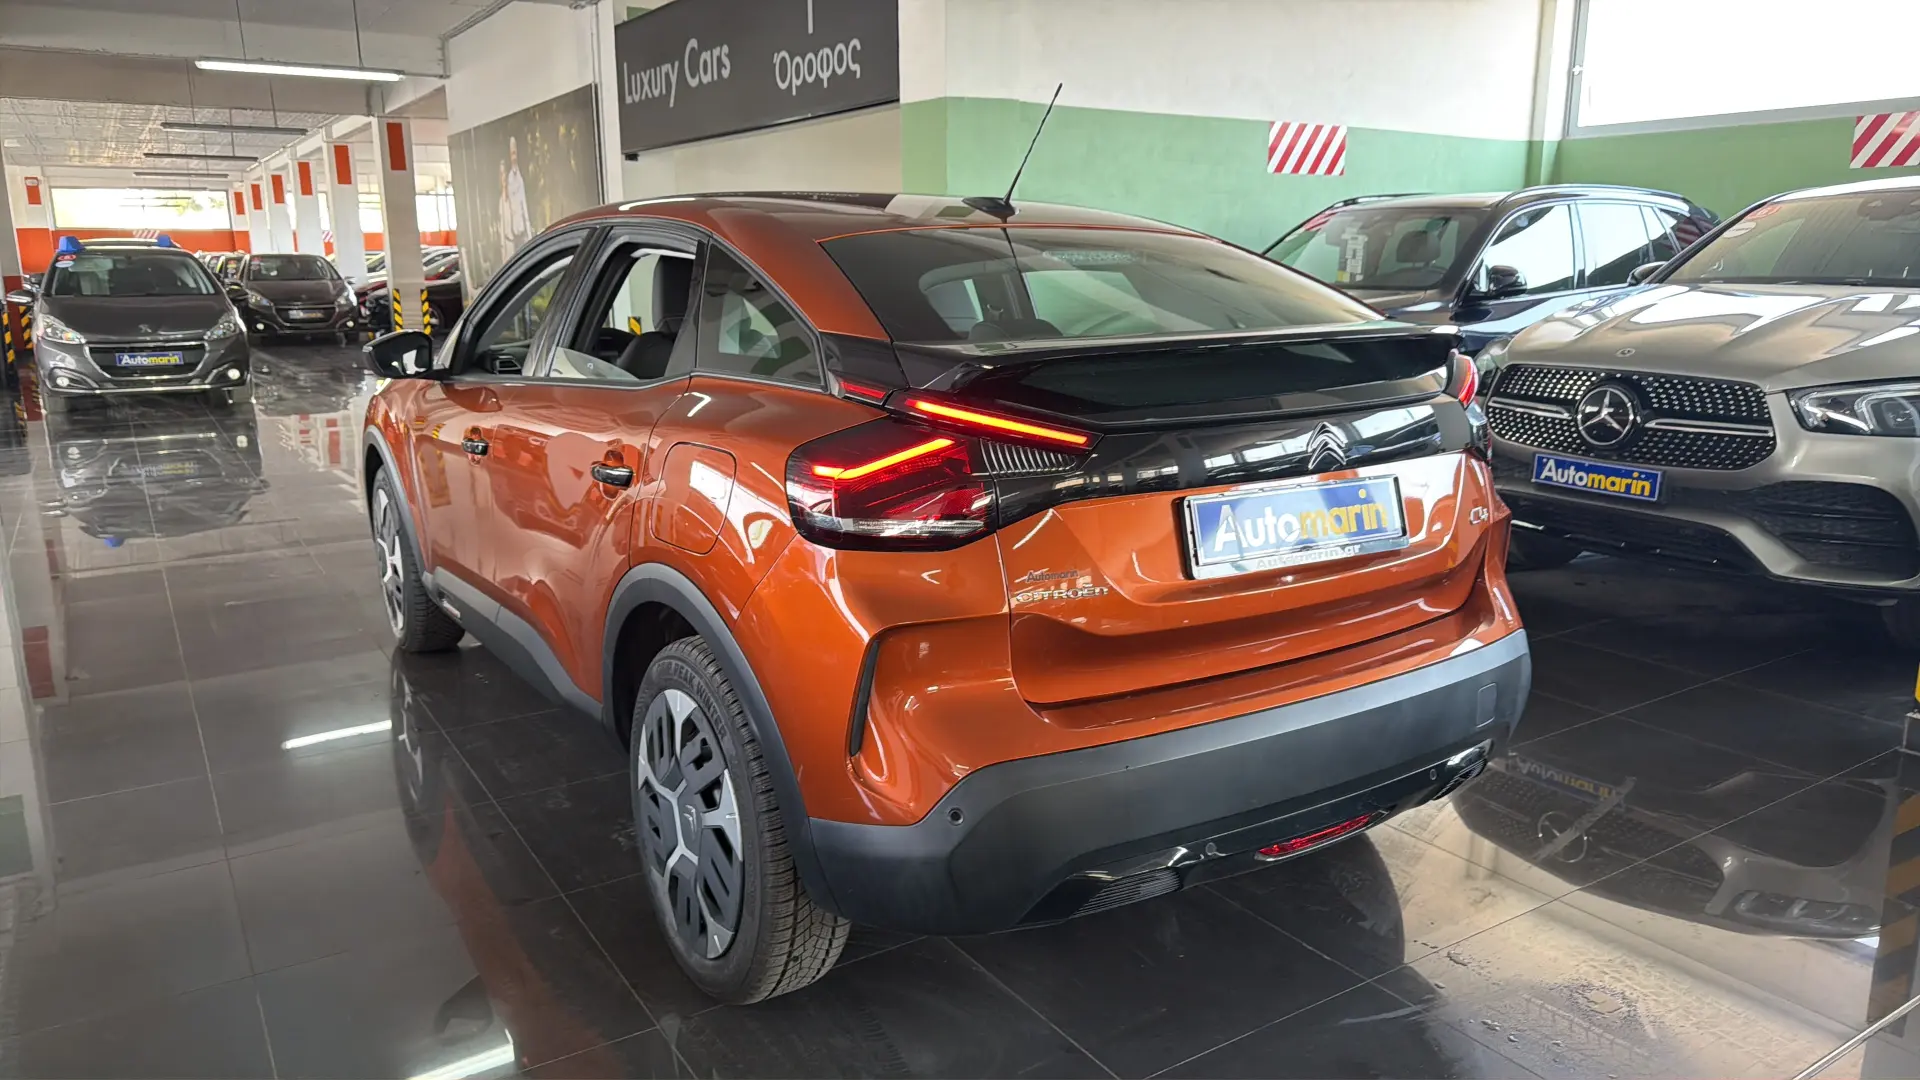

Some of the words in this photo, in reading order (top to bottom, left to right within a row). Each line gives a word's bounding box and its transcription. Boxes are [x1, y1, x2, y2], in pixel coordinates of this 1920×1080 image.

[623, 61, 679, 108] Luxury
[684, 38, 731, 88] Cars
[773, 38, 861, 96] Όροφος
[121, 354, 179, 366] Automarin
[1540, 458, 1651, 496] Automarin
[1214, 488, 1388, 551] Automarin
[1025, 568, 1079, 583] Automarin
